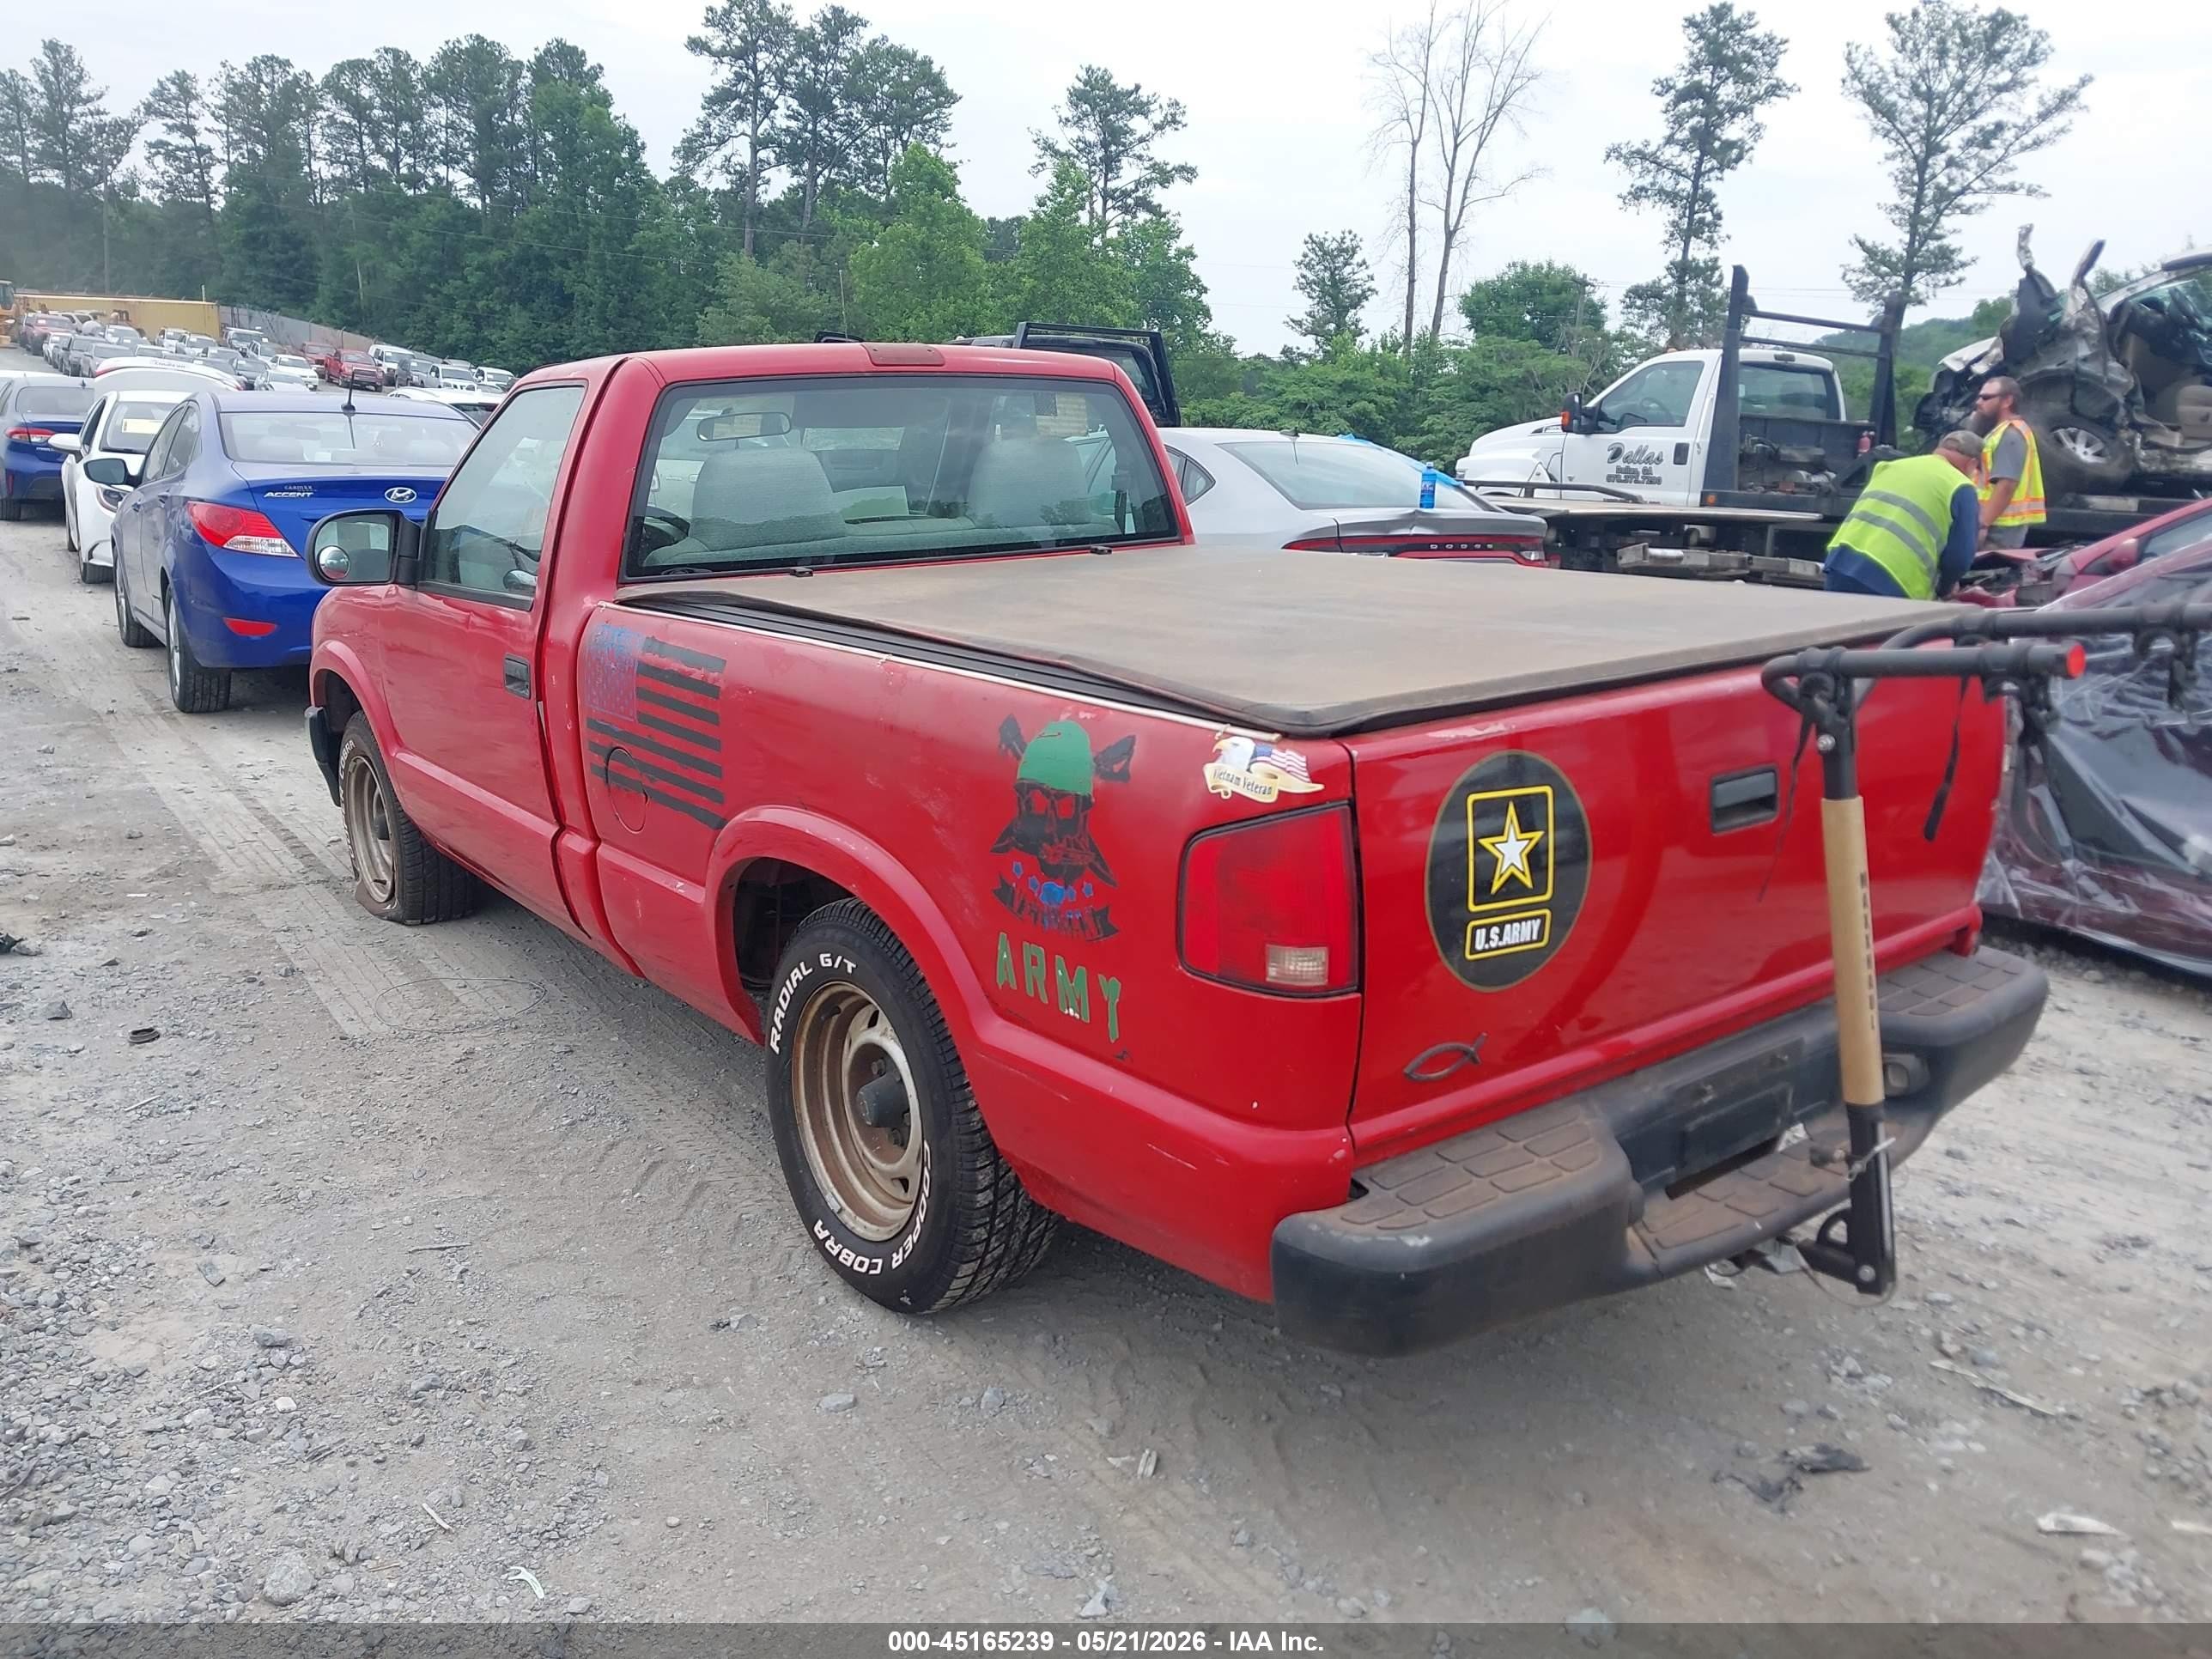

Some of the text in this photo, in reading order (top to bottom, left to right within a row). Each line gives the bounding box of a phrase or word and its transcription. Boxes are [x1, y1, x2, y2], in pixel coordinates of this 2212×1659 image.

[1607, 441, 1664, 465] Dallas
[339, 739, 356, 780] COBRA
[1212, 769, 1273, 796] Vietnam Veteran
[769, 952, 857, 1055] RADIAL G/T
[996, 932, 1122, 1043] ARMY
[813, 1139, 931, 1275] COOPER COBRA
